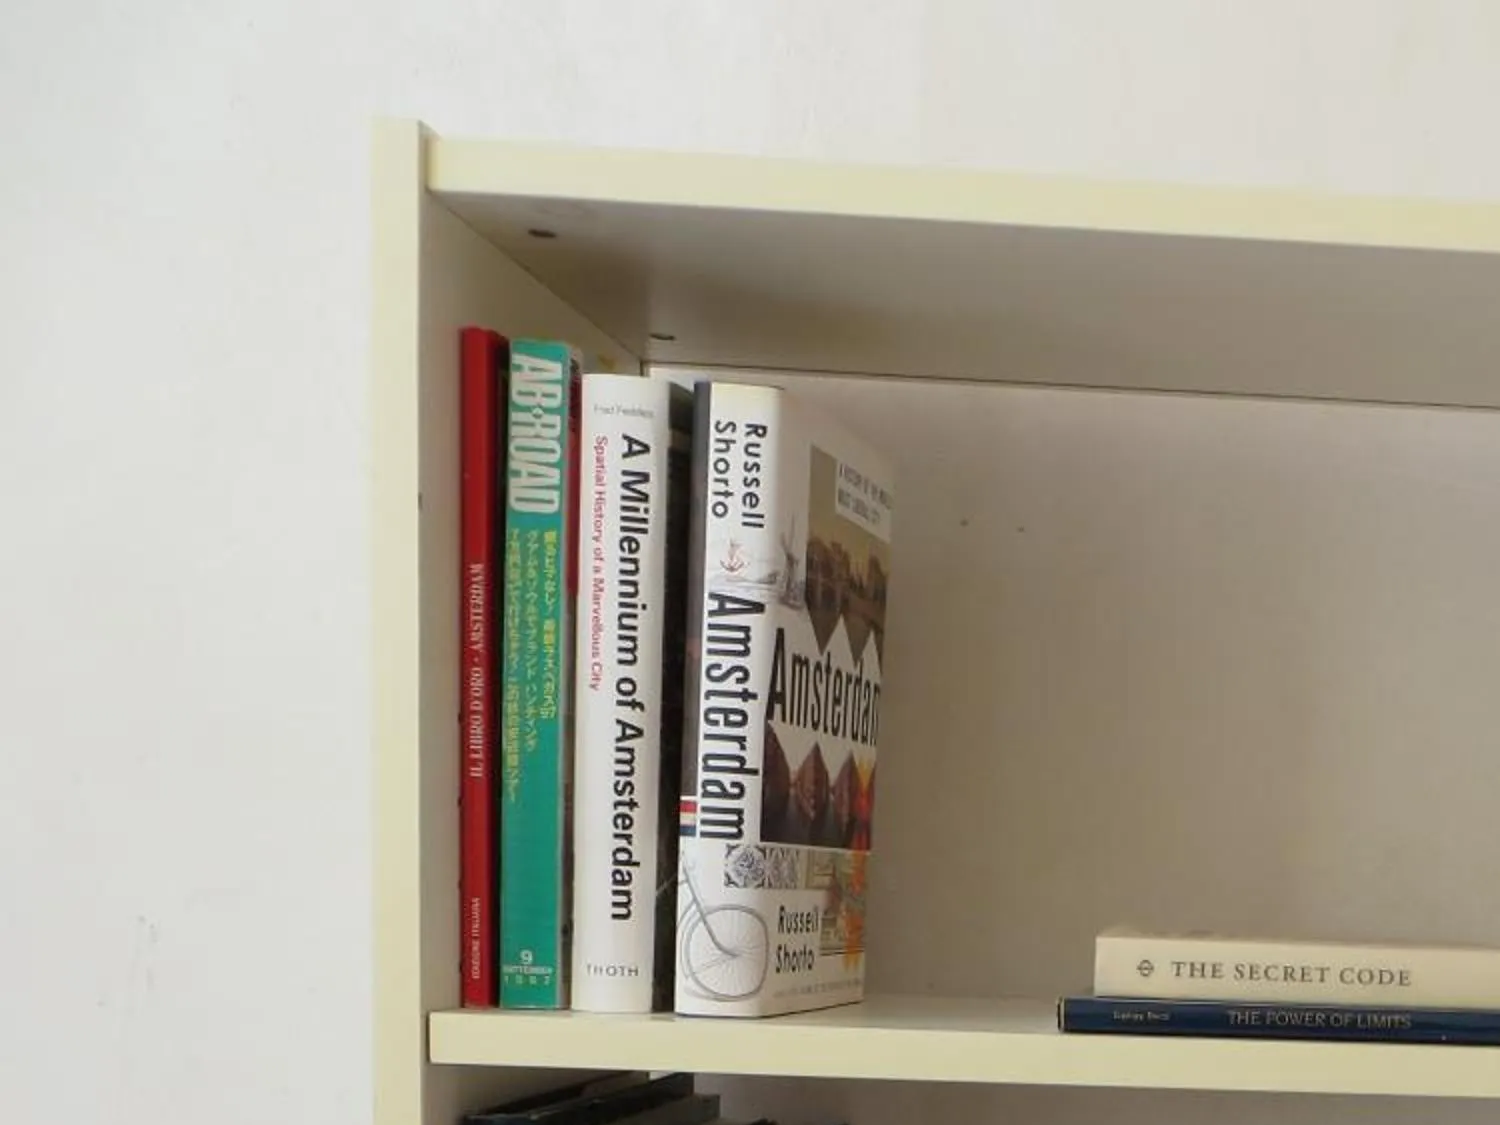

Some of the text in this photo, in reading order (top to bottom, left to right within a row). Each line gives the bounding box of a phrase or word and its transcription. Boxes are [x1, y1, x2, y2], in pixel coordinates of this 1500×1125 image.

[711, 419, 737, 519] Shorto
[742, 423, 768, 529] Russell
[470, 564, 485, 653] AMSTERDAM
[589, 435, 608, 691] Spatial History of a Marvellous City
[610, 433, 650, 921] A Millennium of Amsterdam
[699, 592, 766, 841] Amsterdam
[520, 950, 533, 965] 9
[1172, 961, 1412, 986] THE SECRET CODE
[1227, 1010, 1412, 1028] THE POWER OF LIMITS
